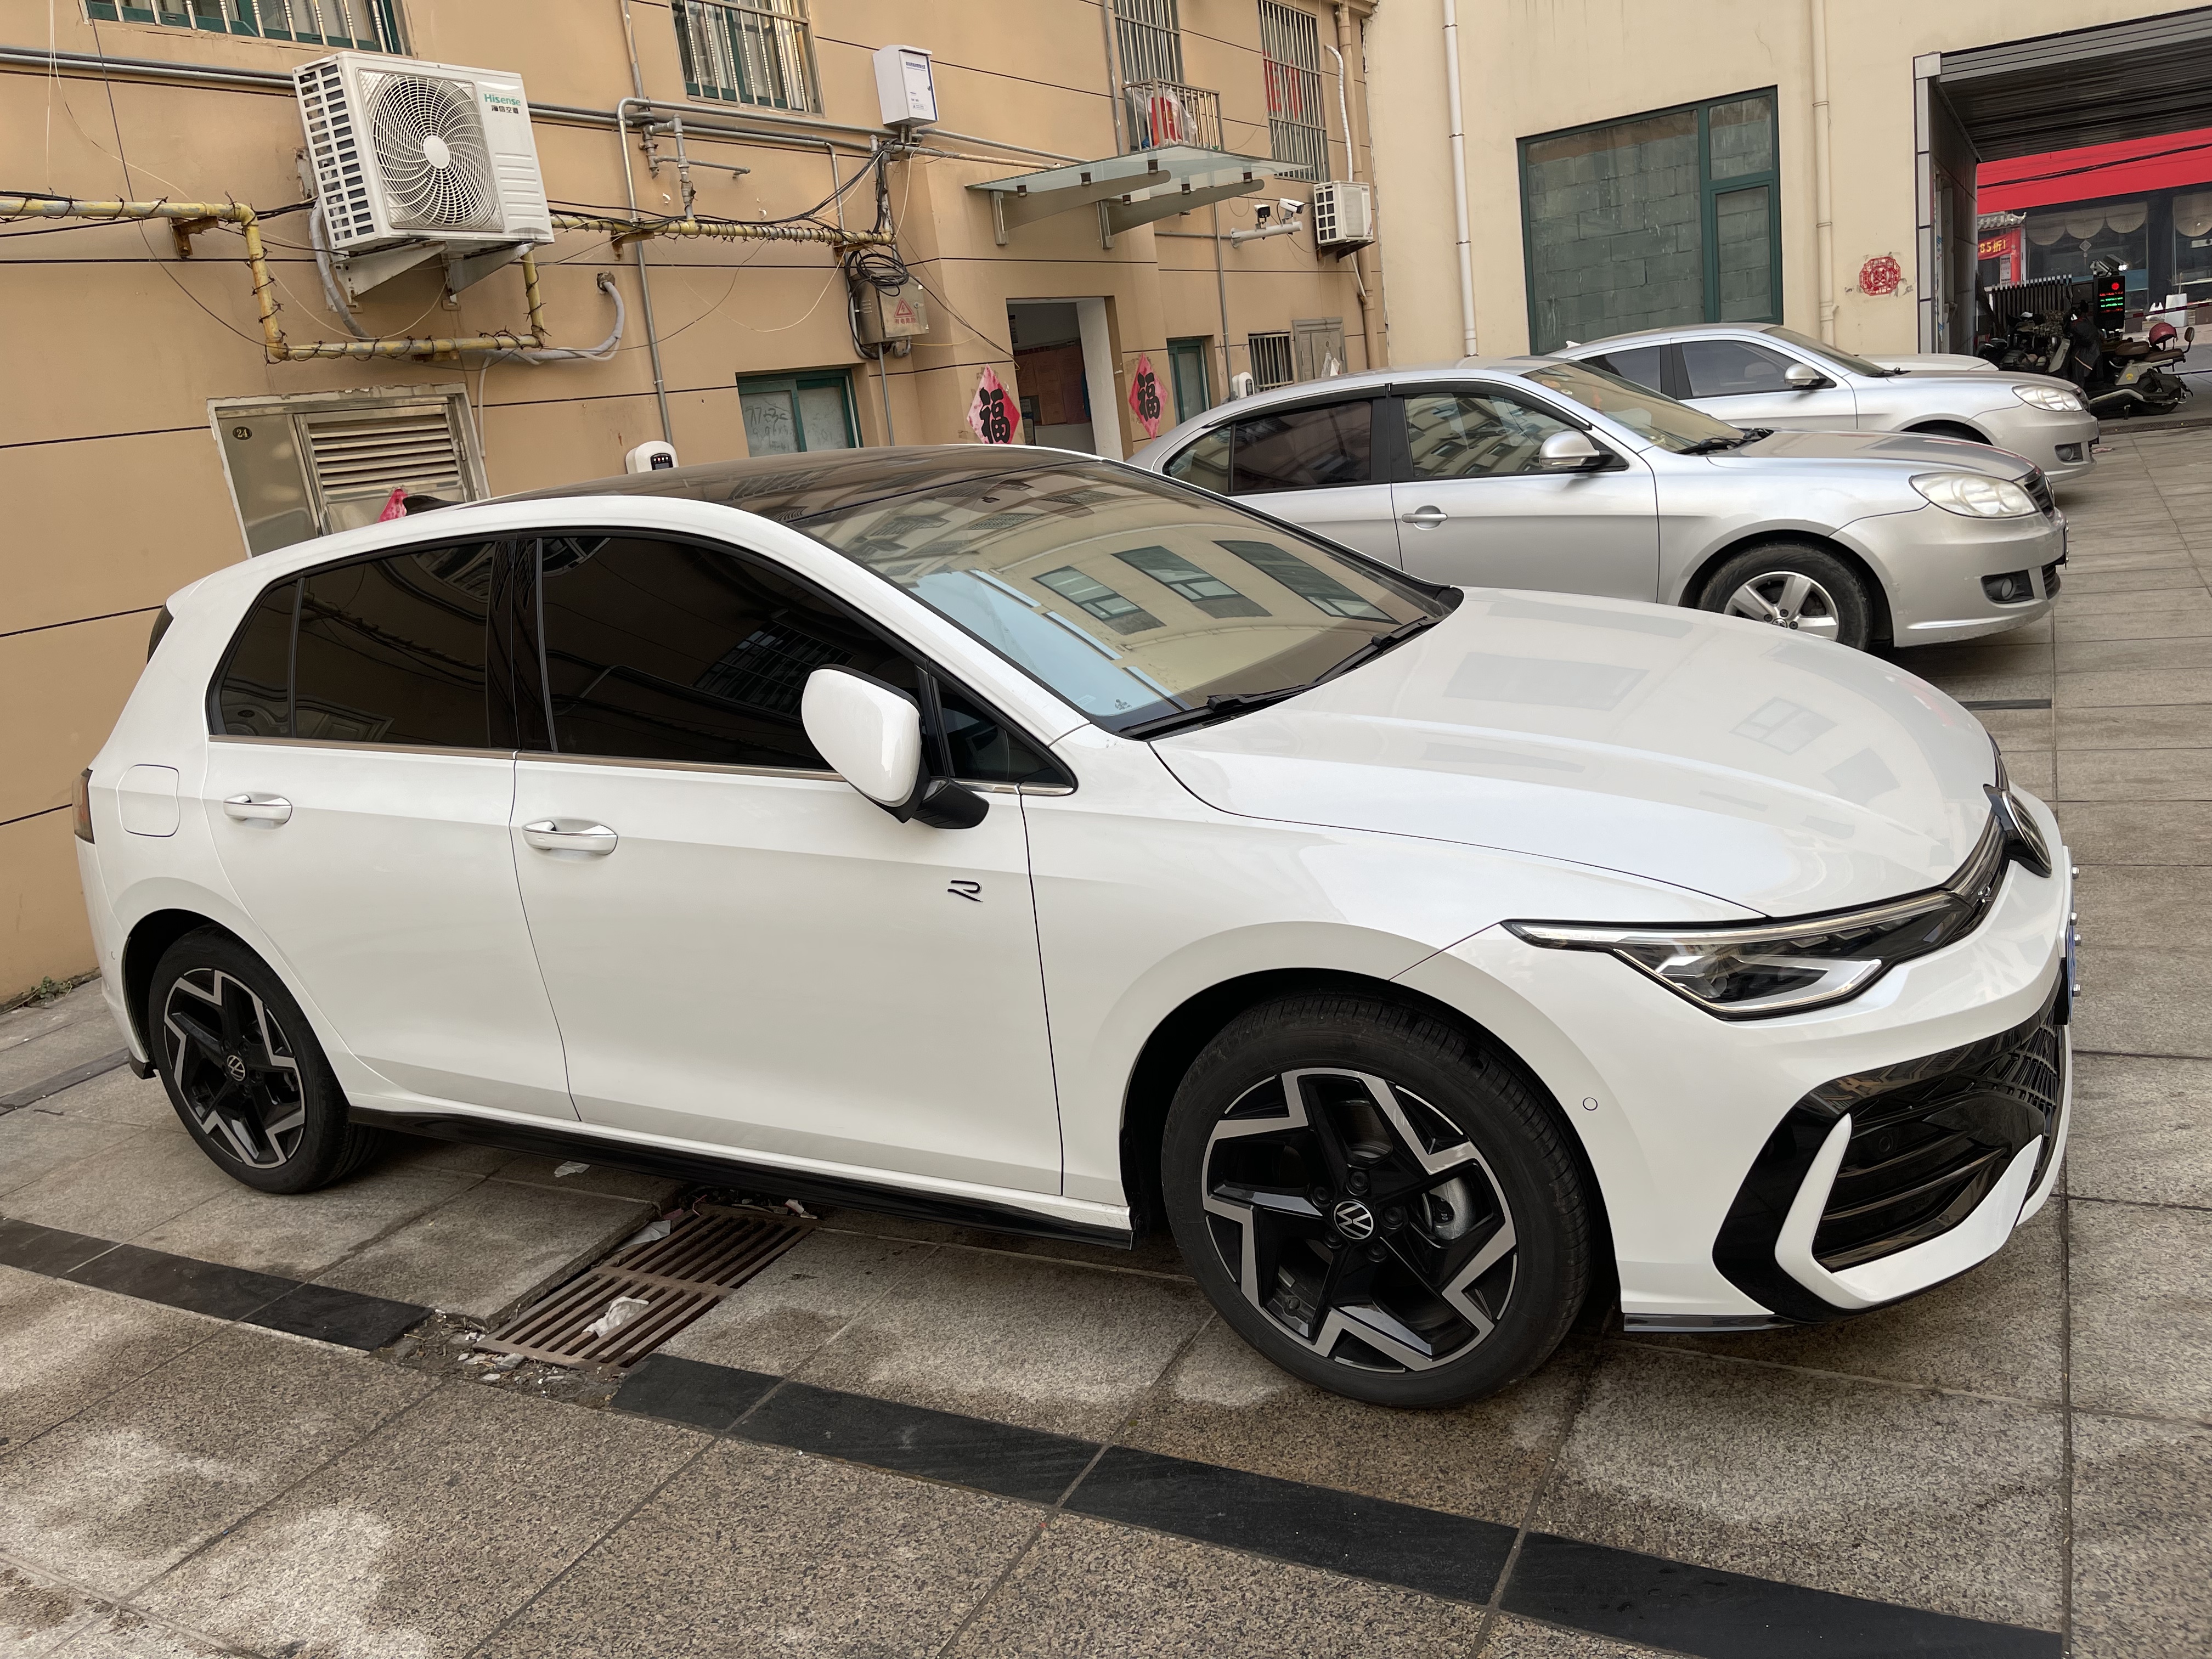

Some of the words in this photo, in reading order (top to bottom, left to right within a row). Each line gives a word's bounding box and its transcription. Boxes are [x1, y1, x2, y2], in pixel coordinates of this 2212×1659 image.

[484, 94, 521, 106] Hisense
[1137, 373, 1160, 422] 福
[979, 387, 1011, 444] 福
[236, 428, 248, 438] 24
[947, 880, 983, 902] R
[1334, 1200, 1374, 1240] VW
